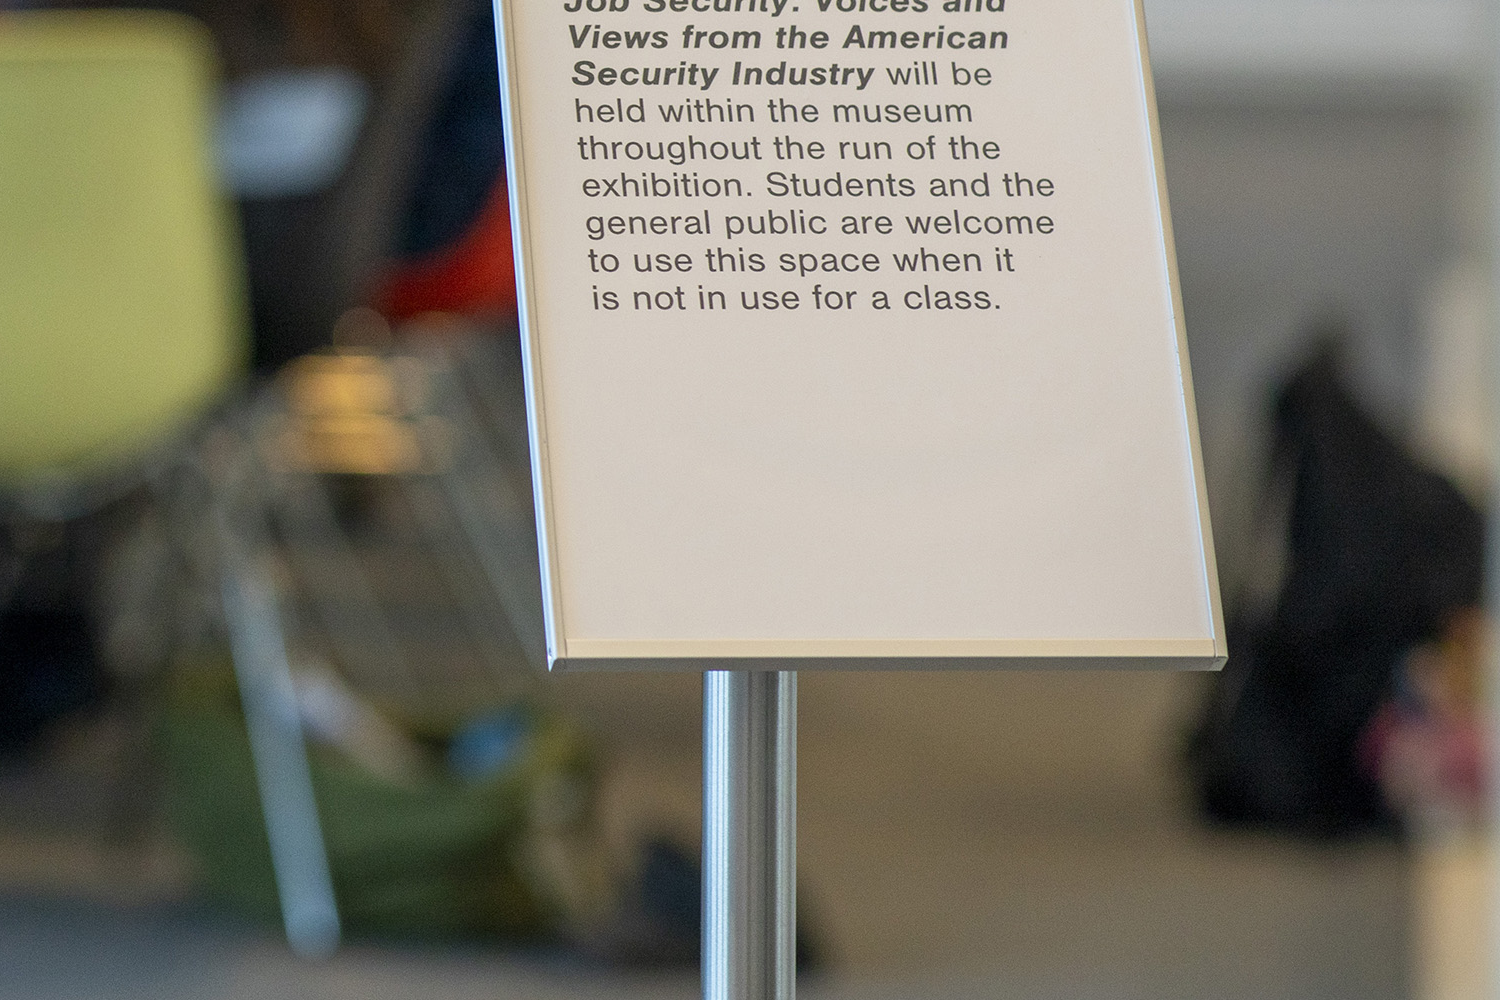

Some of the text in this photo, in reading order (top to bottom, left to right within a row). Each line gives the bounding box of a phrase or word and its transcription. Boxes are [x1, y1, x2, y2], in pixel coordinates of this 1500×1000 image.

[568, 24, 1009, 50] Views from the American
[571, 60, 992, 91] Security Industry will be
[574, 97, 973, 124] held within the museum
[576, 134, 1001, 166] throughout the run of the
[582, 171, 1055, 198] exhibition. Students and the
[585, 209, 1055, 241] general public are welcome
[587, 246, 1016, 278] to use this space when it
[592, 283, 1001, 311] is not in use for a class.
